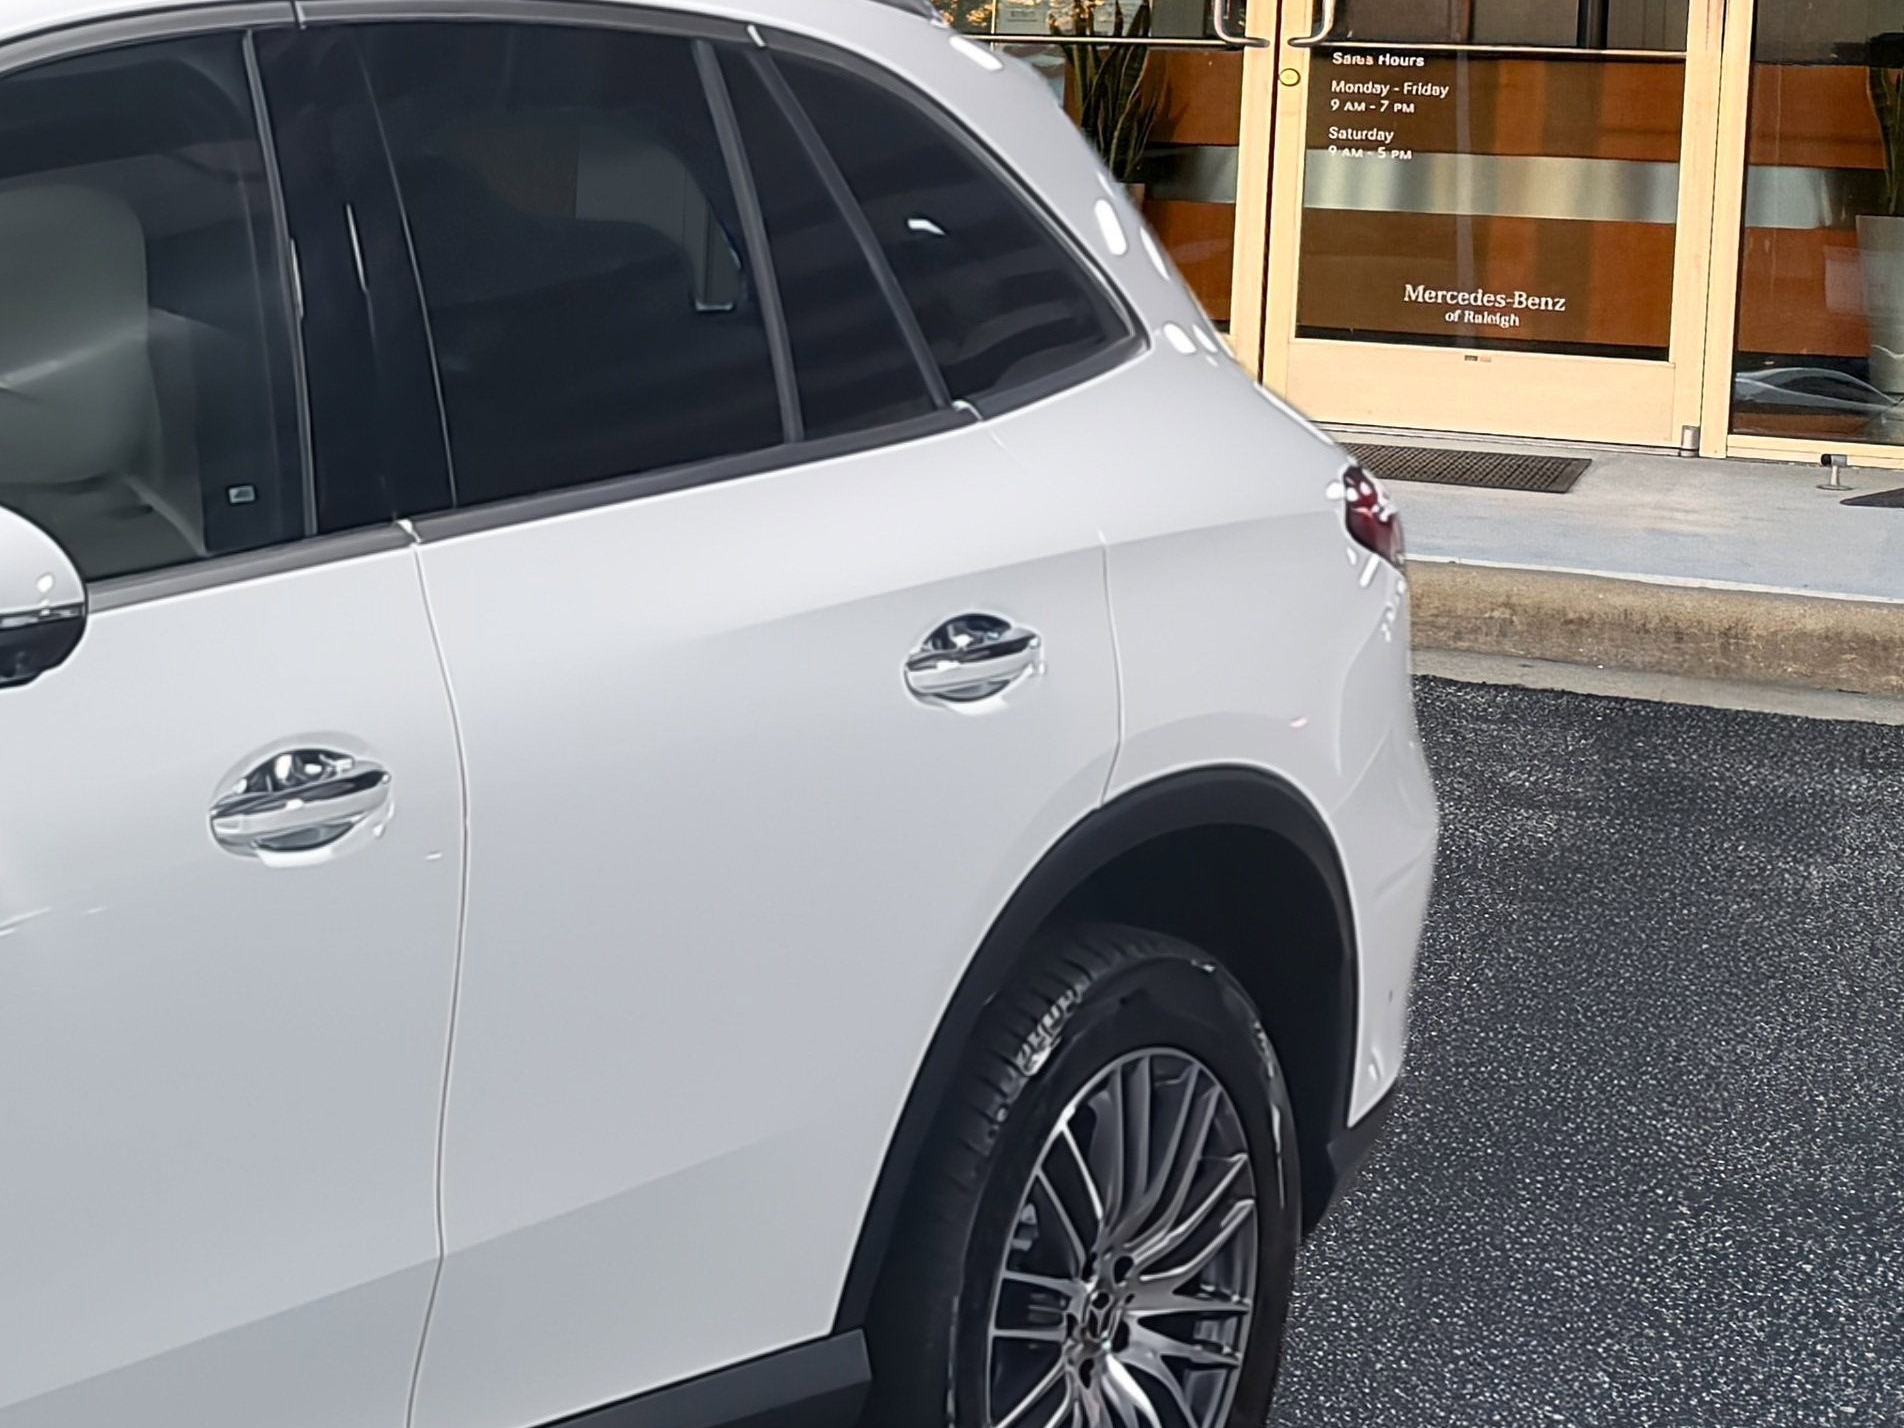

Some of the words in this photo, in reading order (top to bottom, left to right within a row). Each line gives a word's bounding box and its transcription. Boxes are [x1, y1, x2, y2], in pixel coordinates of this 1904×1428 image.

[1378, 53, 1425, 67] Hours
[1331, 80, 1390, 97] Monday
[1403, 82, 1450, 98] Friday
[1330, 98, 1340, 112] 9
[1344, 101, 1366, 112] AM
[1380, 100, 1389, 112] 7
[1393, 102, 1415, 113] PM
[1328, 126, 1394, 143] Saturday
[1328, 145, 1338, 158] 9
[1377, 146, 1387, 159] 5
[1391, 148, 1413, 160] PM
[1403, 283, 1566, 312] Mercedes-Benz
[1444, 309, 1460, 322] of
[1463, 310, 1520, 329] Raleigh
